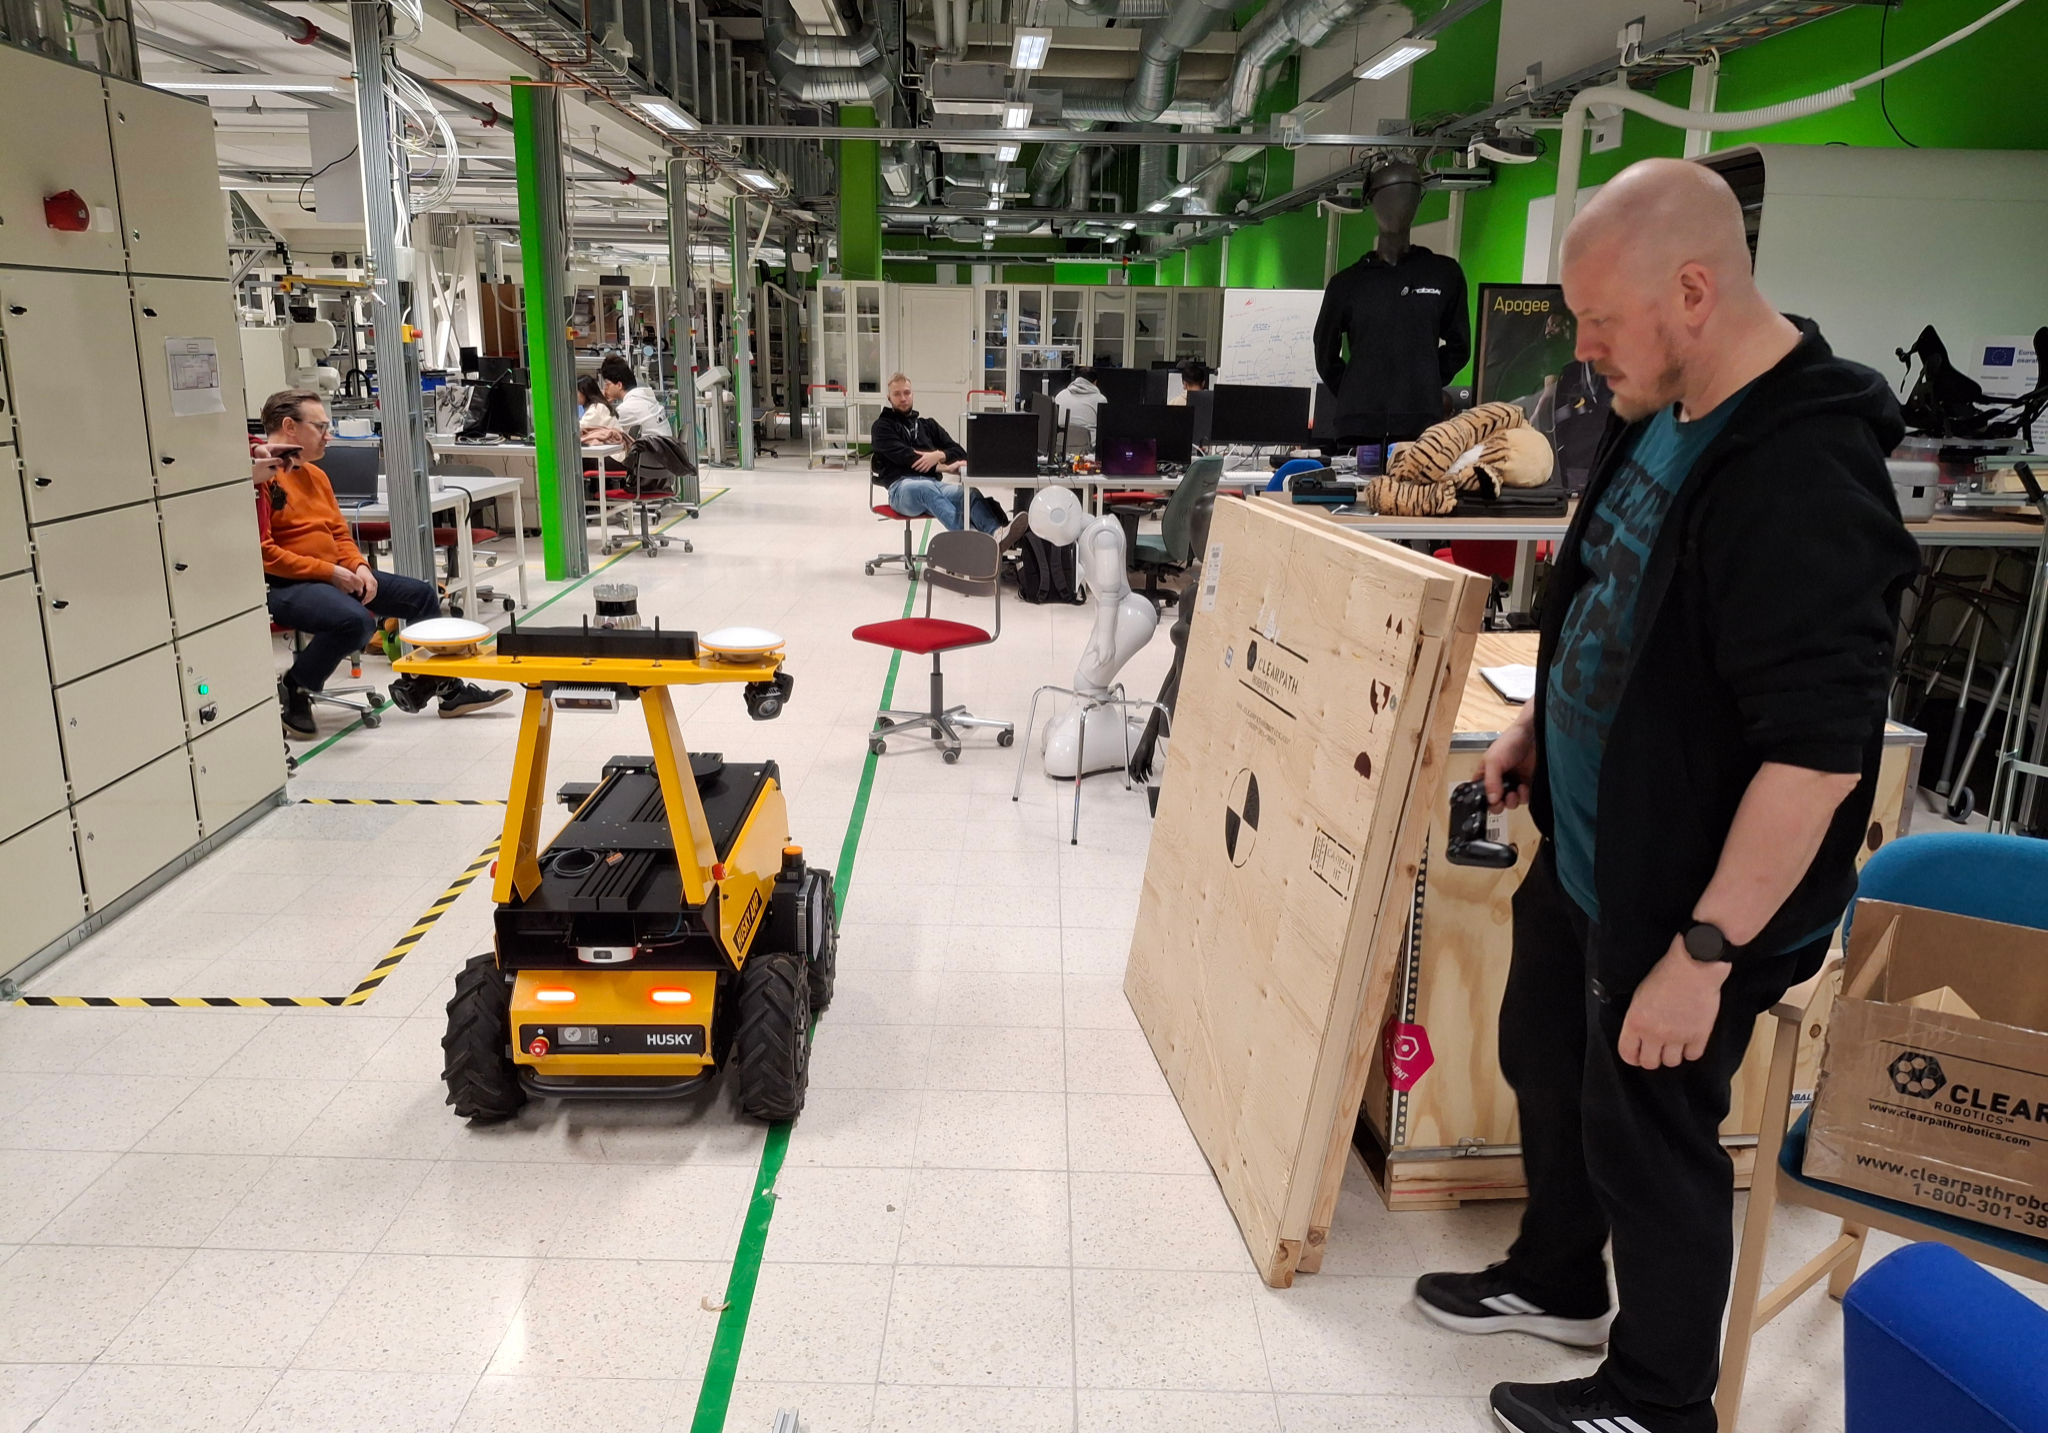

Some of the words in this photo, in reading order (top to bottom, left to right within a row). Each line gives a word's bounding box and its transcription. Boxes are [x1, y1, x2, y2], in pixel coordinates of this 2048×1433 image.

[1494, 296, 1550, 315] Apogee
[1257, 658, 1299, 695] CLEARPATH
[736, 908, 752, 951] HUSKY
[646, 1034, 693, 1045] HUSKY
[1950, 1084, 2048, 1124] CLEAR
[1869, 1102, 2031, 1147] www.clearpathrobotics.com
